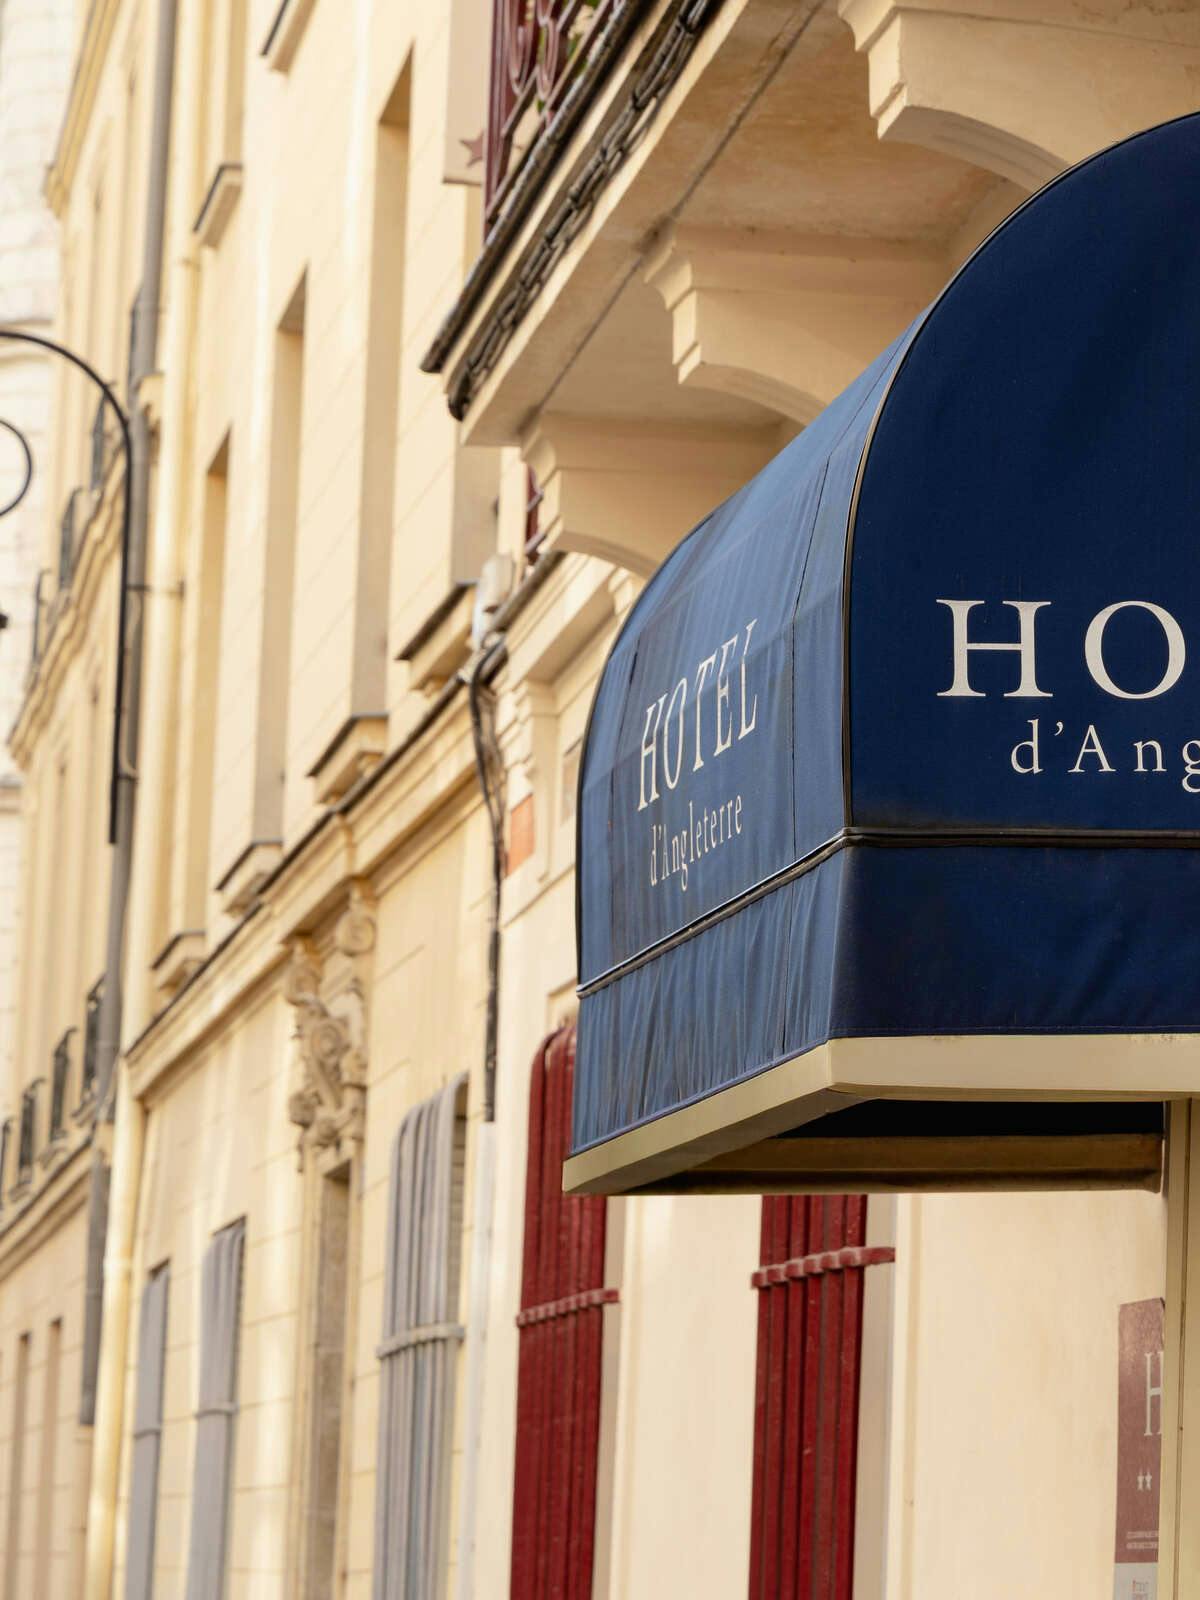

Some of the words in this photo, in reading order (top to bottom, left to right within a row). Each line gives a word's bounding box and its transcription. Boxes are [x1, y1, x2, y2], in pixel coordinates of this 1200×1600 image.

[637, 618, 758, 812] HOTEL
[650, 794, 743, 891] d’Angleterre
[1144, 1351, 1164, 1436] H
